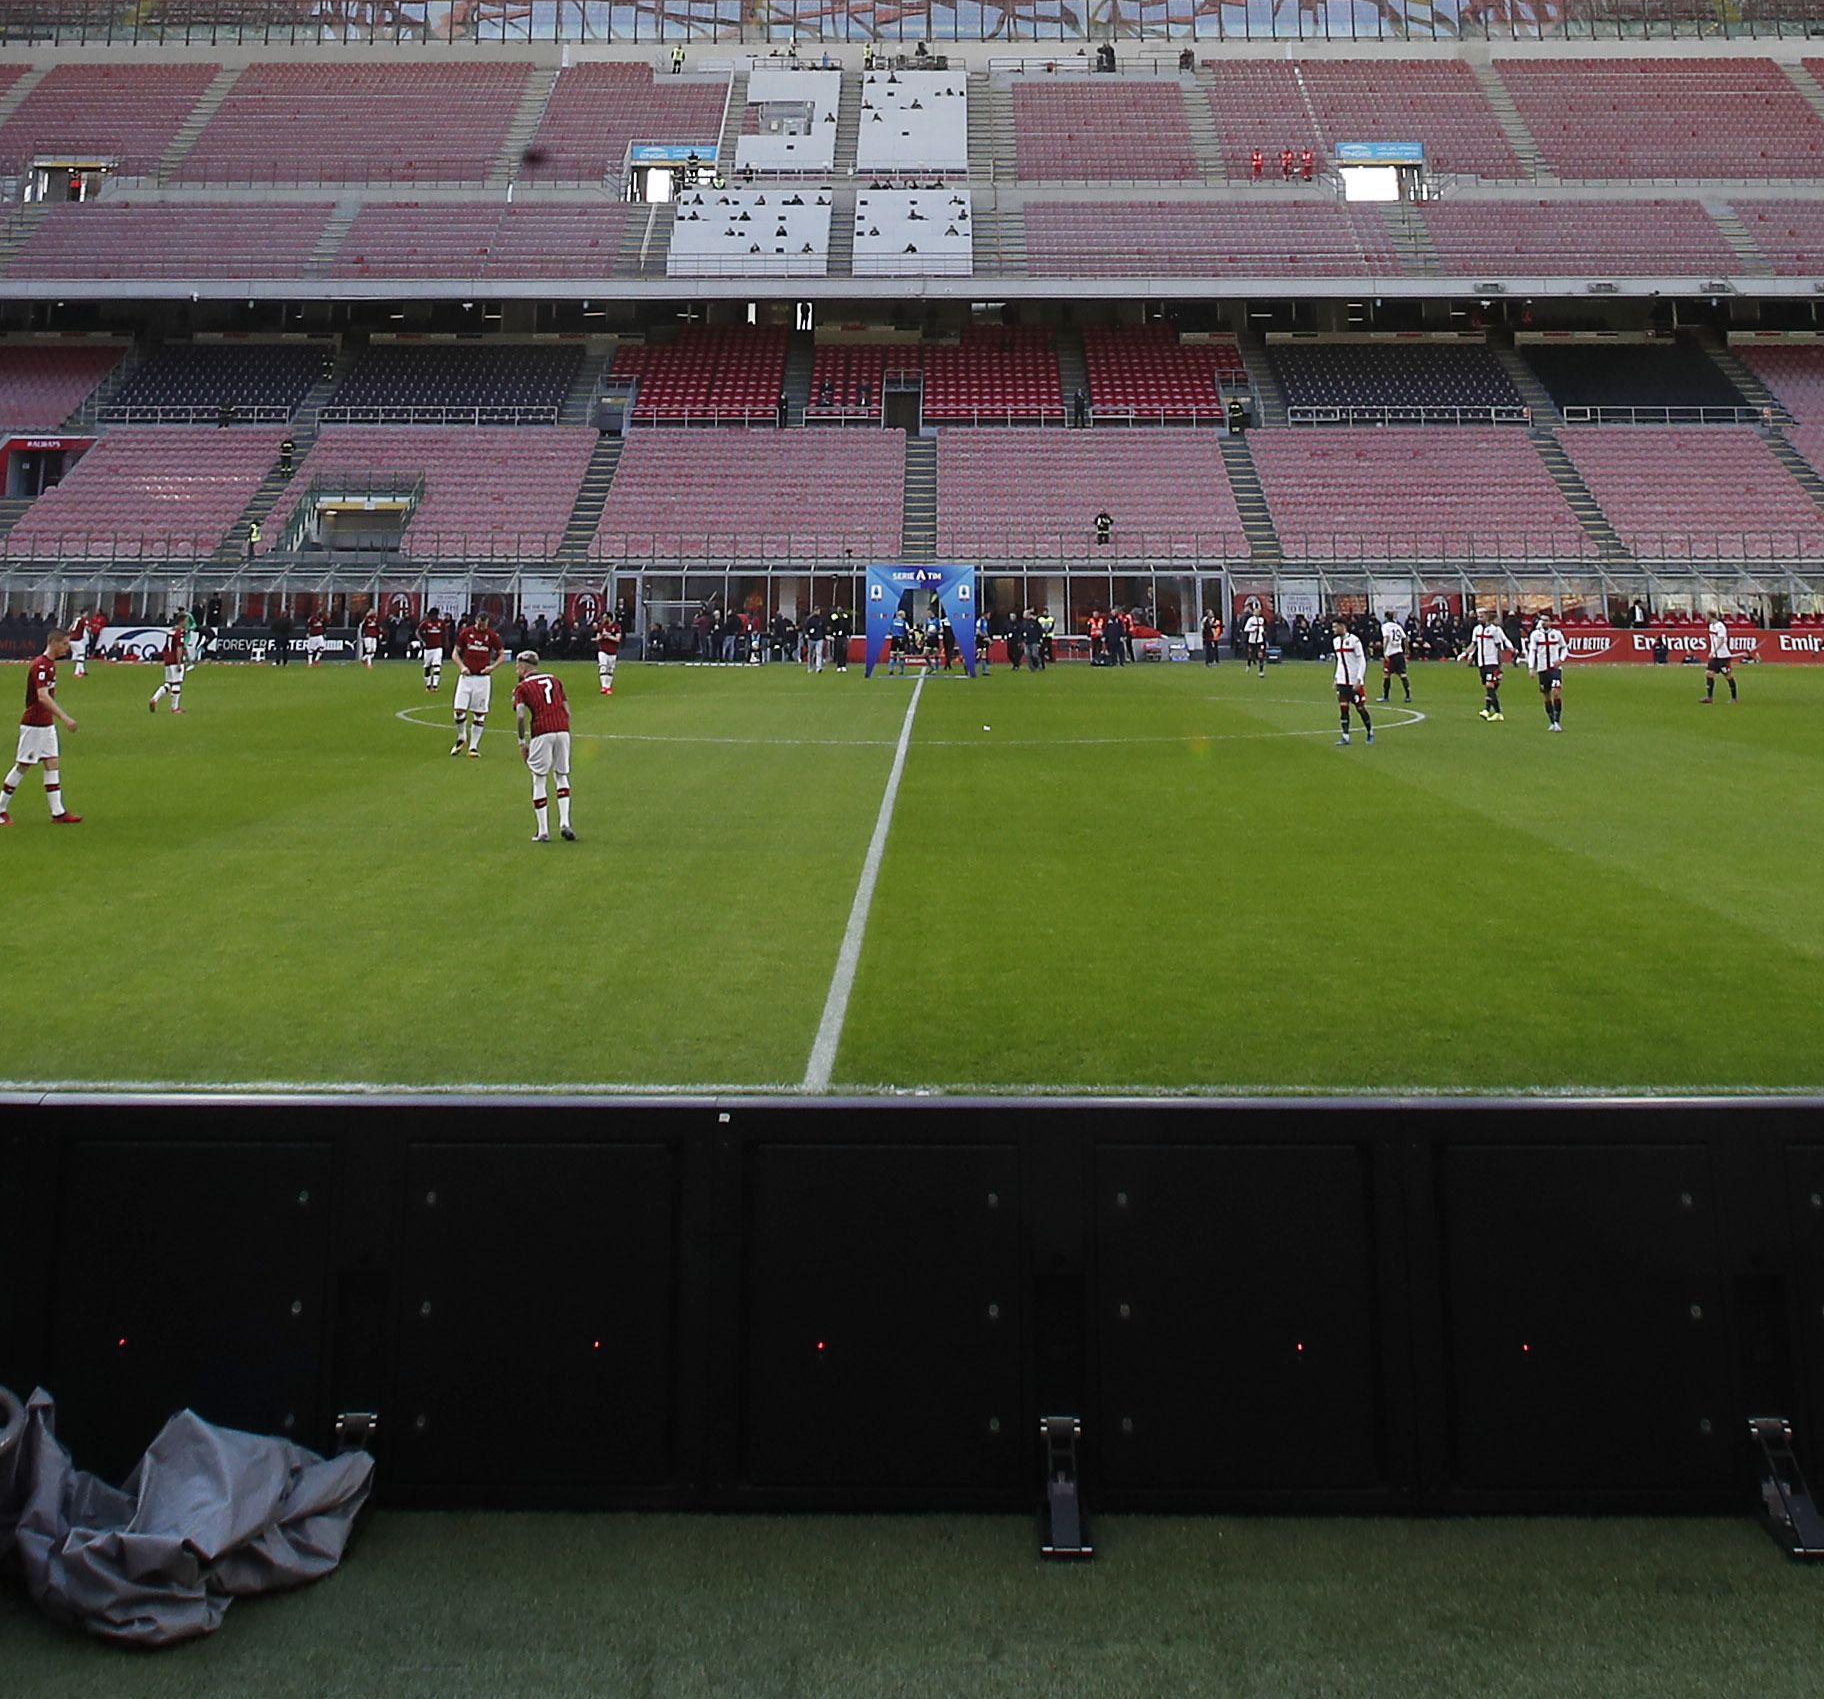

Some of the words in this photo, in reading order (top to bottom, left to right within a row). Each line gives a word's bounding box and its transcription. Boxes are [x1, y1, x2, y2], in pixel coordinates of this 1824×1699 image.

[892, 572, 915, 580] SERIE
[916, 569, 927, 580] A
[927, 572, 942, 580] TIM
[1391, 629, 1401, 642] 19
[217, 638, 268, 650] FOREVER
[1583, 637, 1611, 650] BETTER
[537, 678, 554, 704] 7
